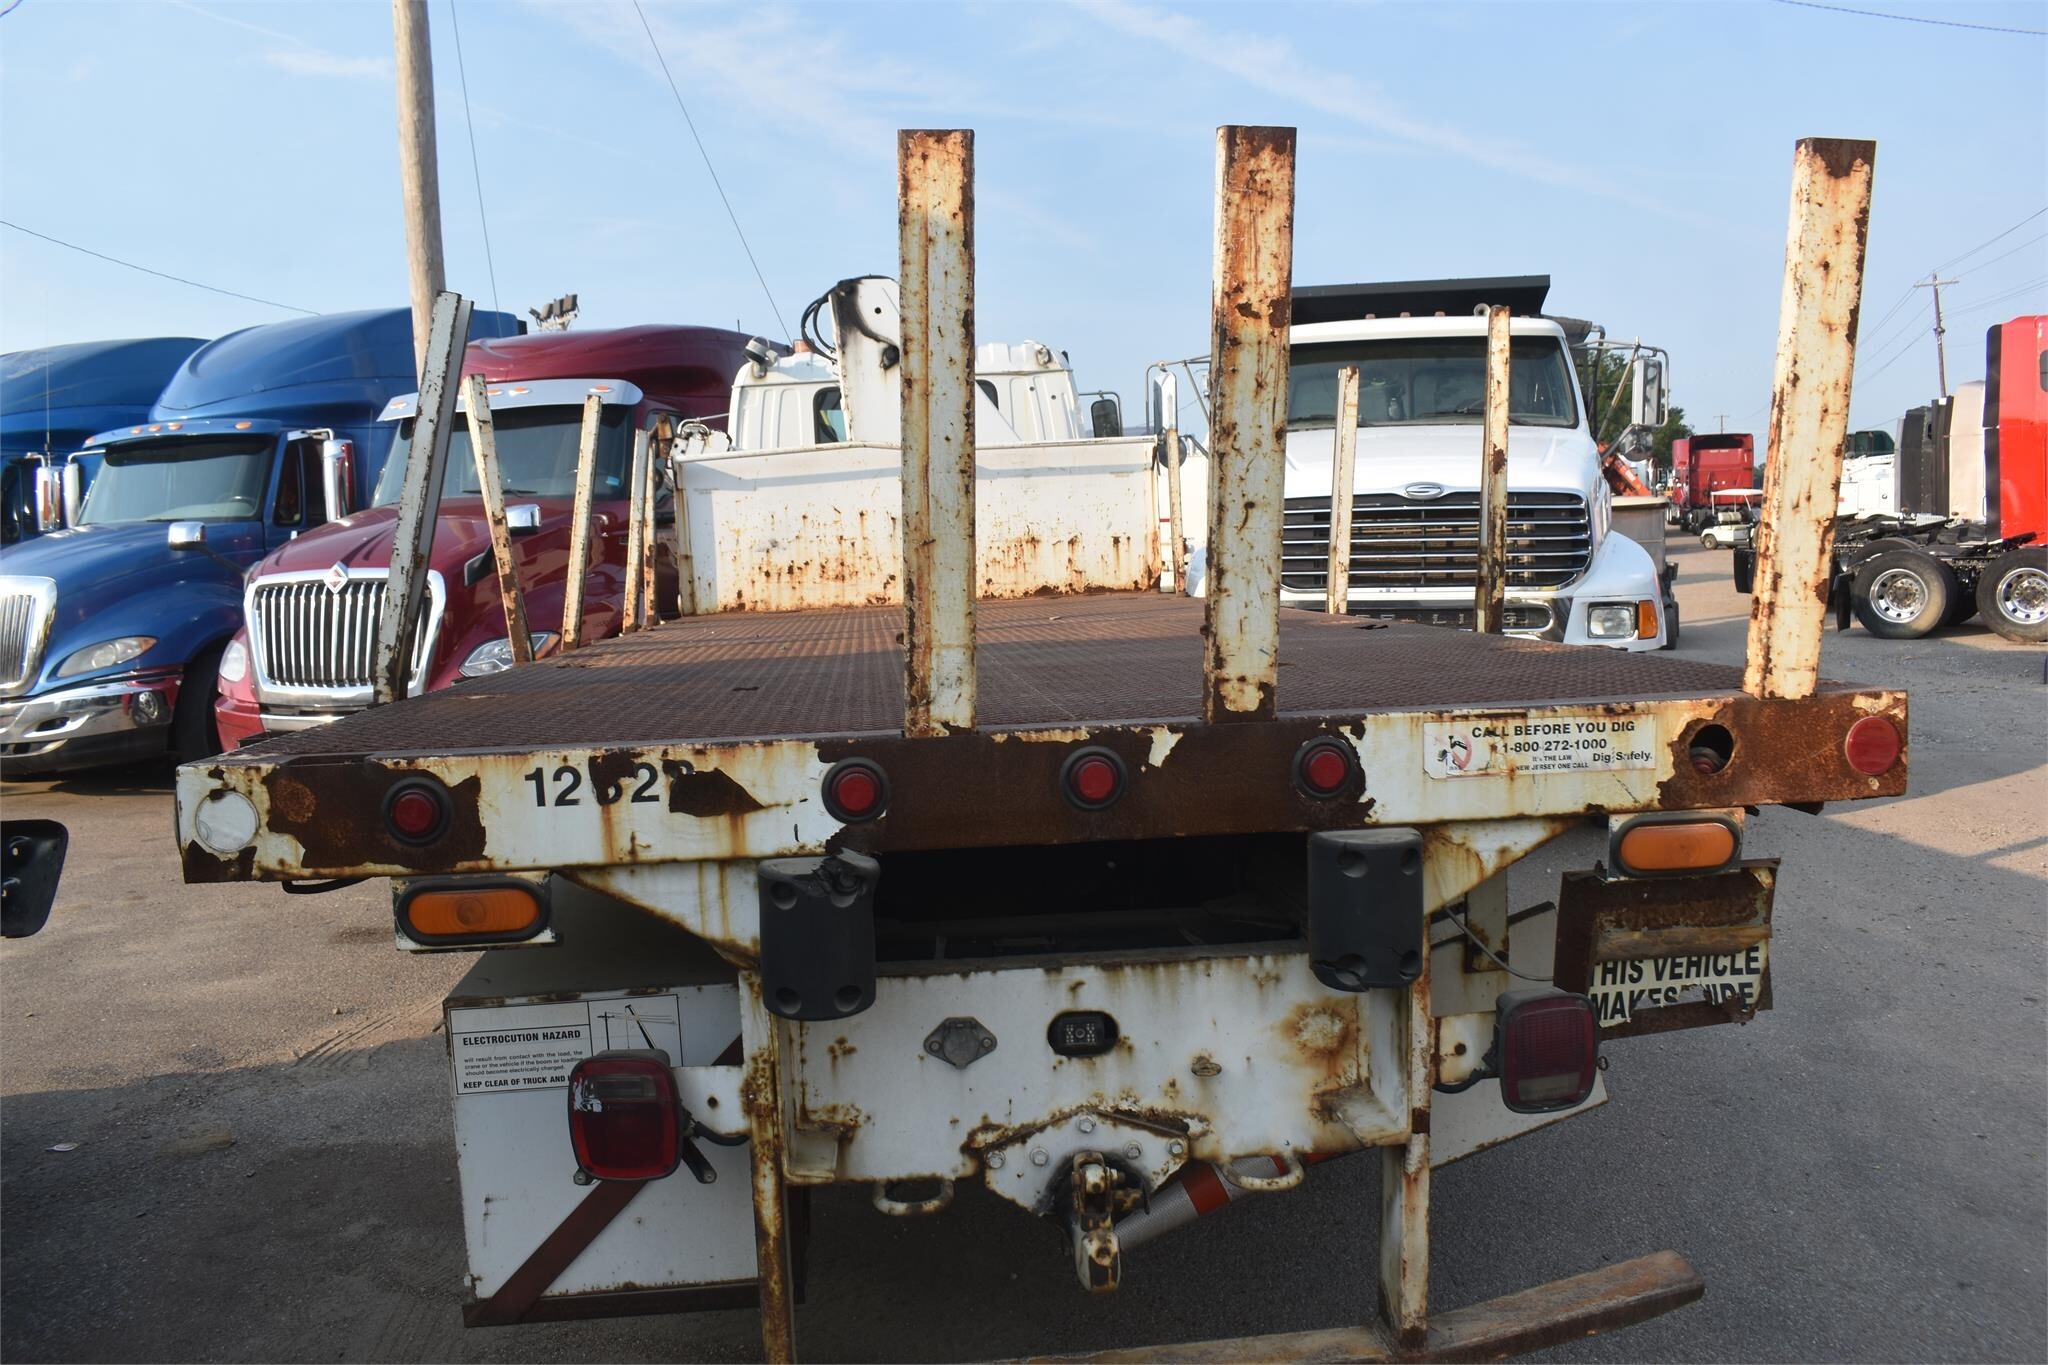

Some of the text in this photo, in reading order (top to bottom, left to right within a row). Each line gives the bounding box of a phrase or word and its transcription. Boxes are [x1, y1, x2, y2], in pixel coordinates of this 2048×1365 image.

[1471, 720, 1636, 739] CALL BEFORE YOU DIG
[1531, 763, 1556, 771] JERSEY
[1592, 753, 1611, 764] Dig
[524, 759, 696, 808] 122
[1653, 945, 1761, 982] VEHICLE
[463, 1029, 581, 1046] ELECTROCUTION HAZARD
[463, 1079, 482, 1089] KEEP
[485, 1078, 509, 1088] CLEAR
[510, 1077, 521, 1086] OF
[523, 1076, 547, 1085] TRUCK
[550, 1074, 566, 1083] AND
